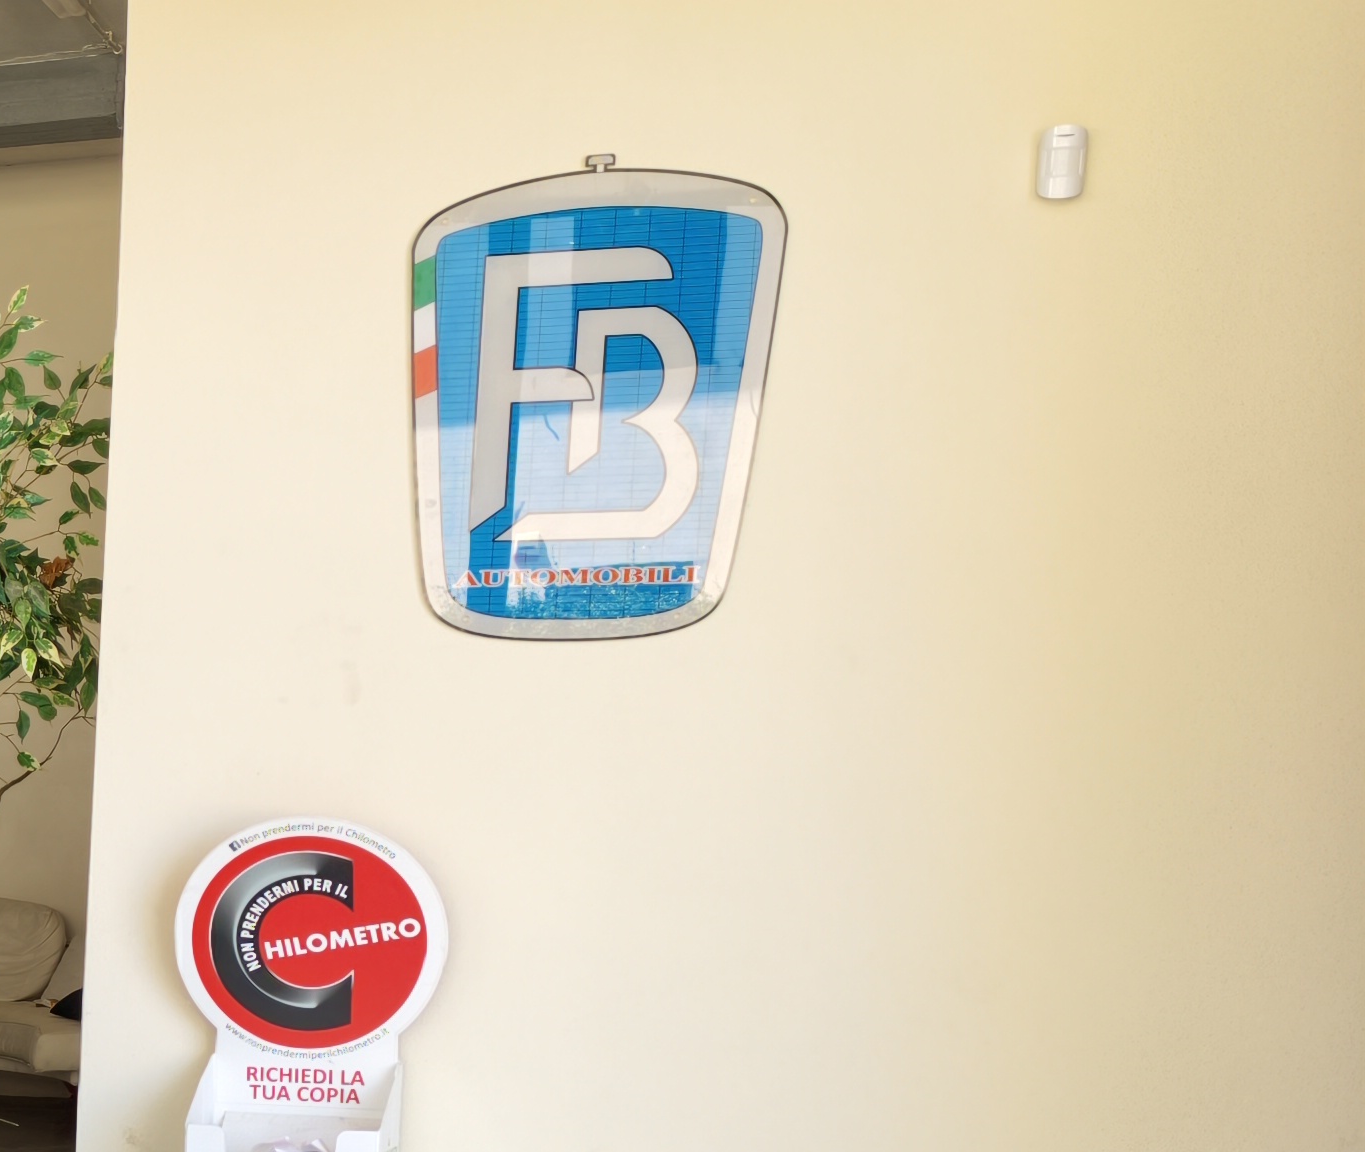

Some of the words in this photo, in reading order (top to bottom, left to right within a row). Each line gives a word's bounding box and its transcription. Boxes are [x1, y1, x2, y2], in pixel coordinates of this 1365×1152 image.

[453, 565, 703, 588] AUTOMOBILI
[240, 833, 261, 847] Non
[262, 823, 315, 838] prendermi
[317, 824, 334, 833] per
[345, 828, 396, 859] Chilometro
[304, 878, 332, 893] PER
[335, 883, 349, 899] IL
[240, 880, 300, 938] PRENDERMI
[240, 942, 261, 972] NON
[225, 1022, 390, 1060] www.nonprendermiperilchilometro.it
[246, 1066, 334, 1085] RICHIEDI
[340, 1070, 365, 1086] LA
[249, 1084, 291, 1101] TUA
[296, 1087, 361, 1104] COPIA
